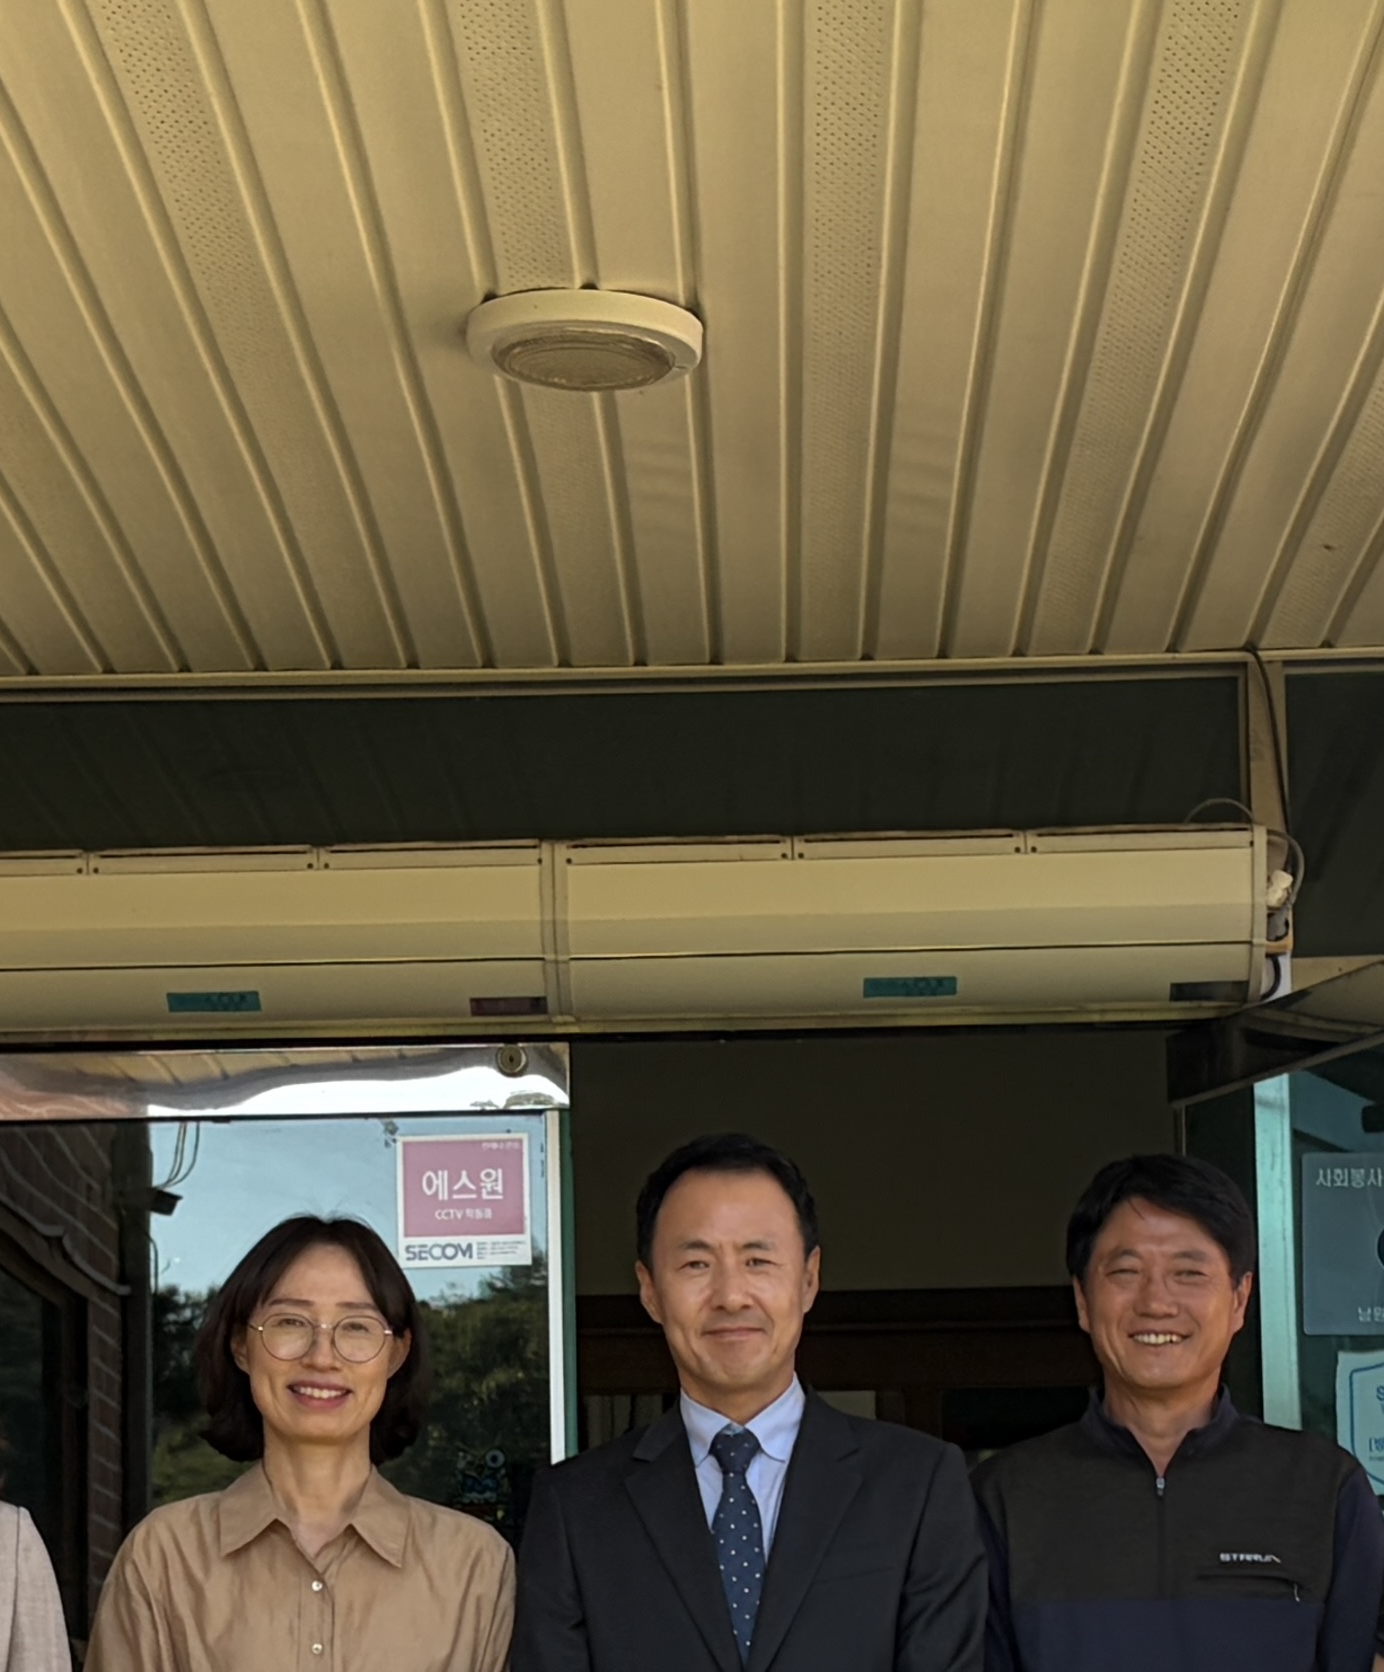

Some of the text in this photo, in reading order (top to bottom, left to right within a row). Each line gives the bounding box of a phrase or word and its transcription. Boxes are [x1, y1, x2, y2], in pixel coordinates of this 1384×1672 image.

[421, 1167, 504, 1201] 에스원
[1316, 1167, 1383, 1189] 사회봉사
[435, 1208, 464, 1221] CCTV
[404, 1242, 474, 1261] SECOM
